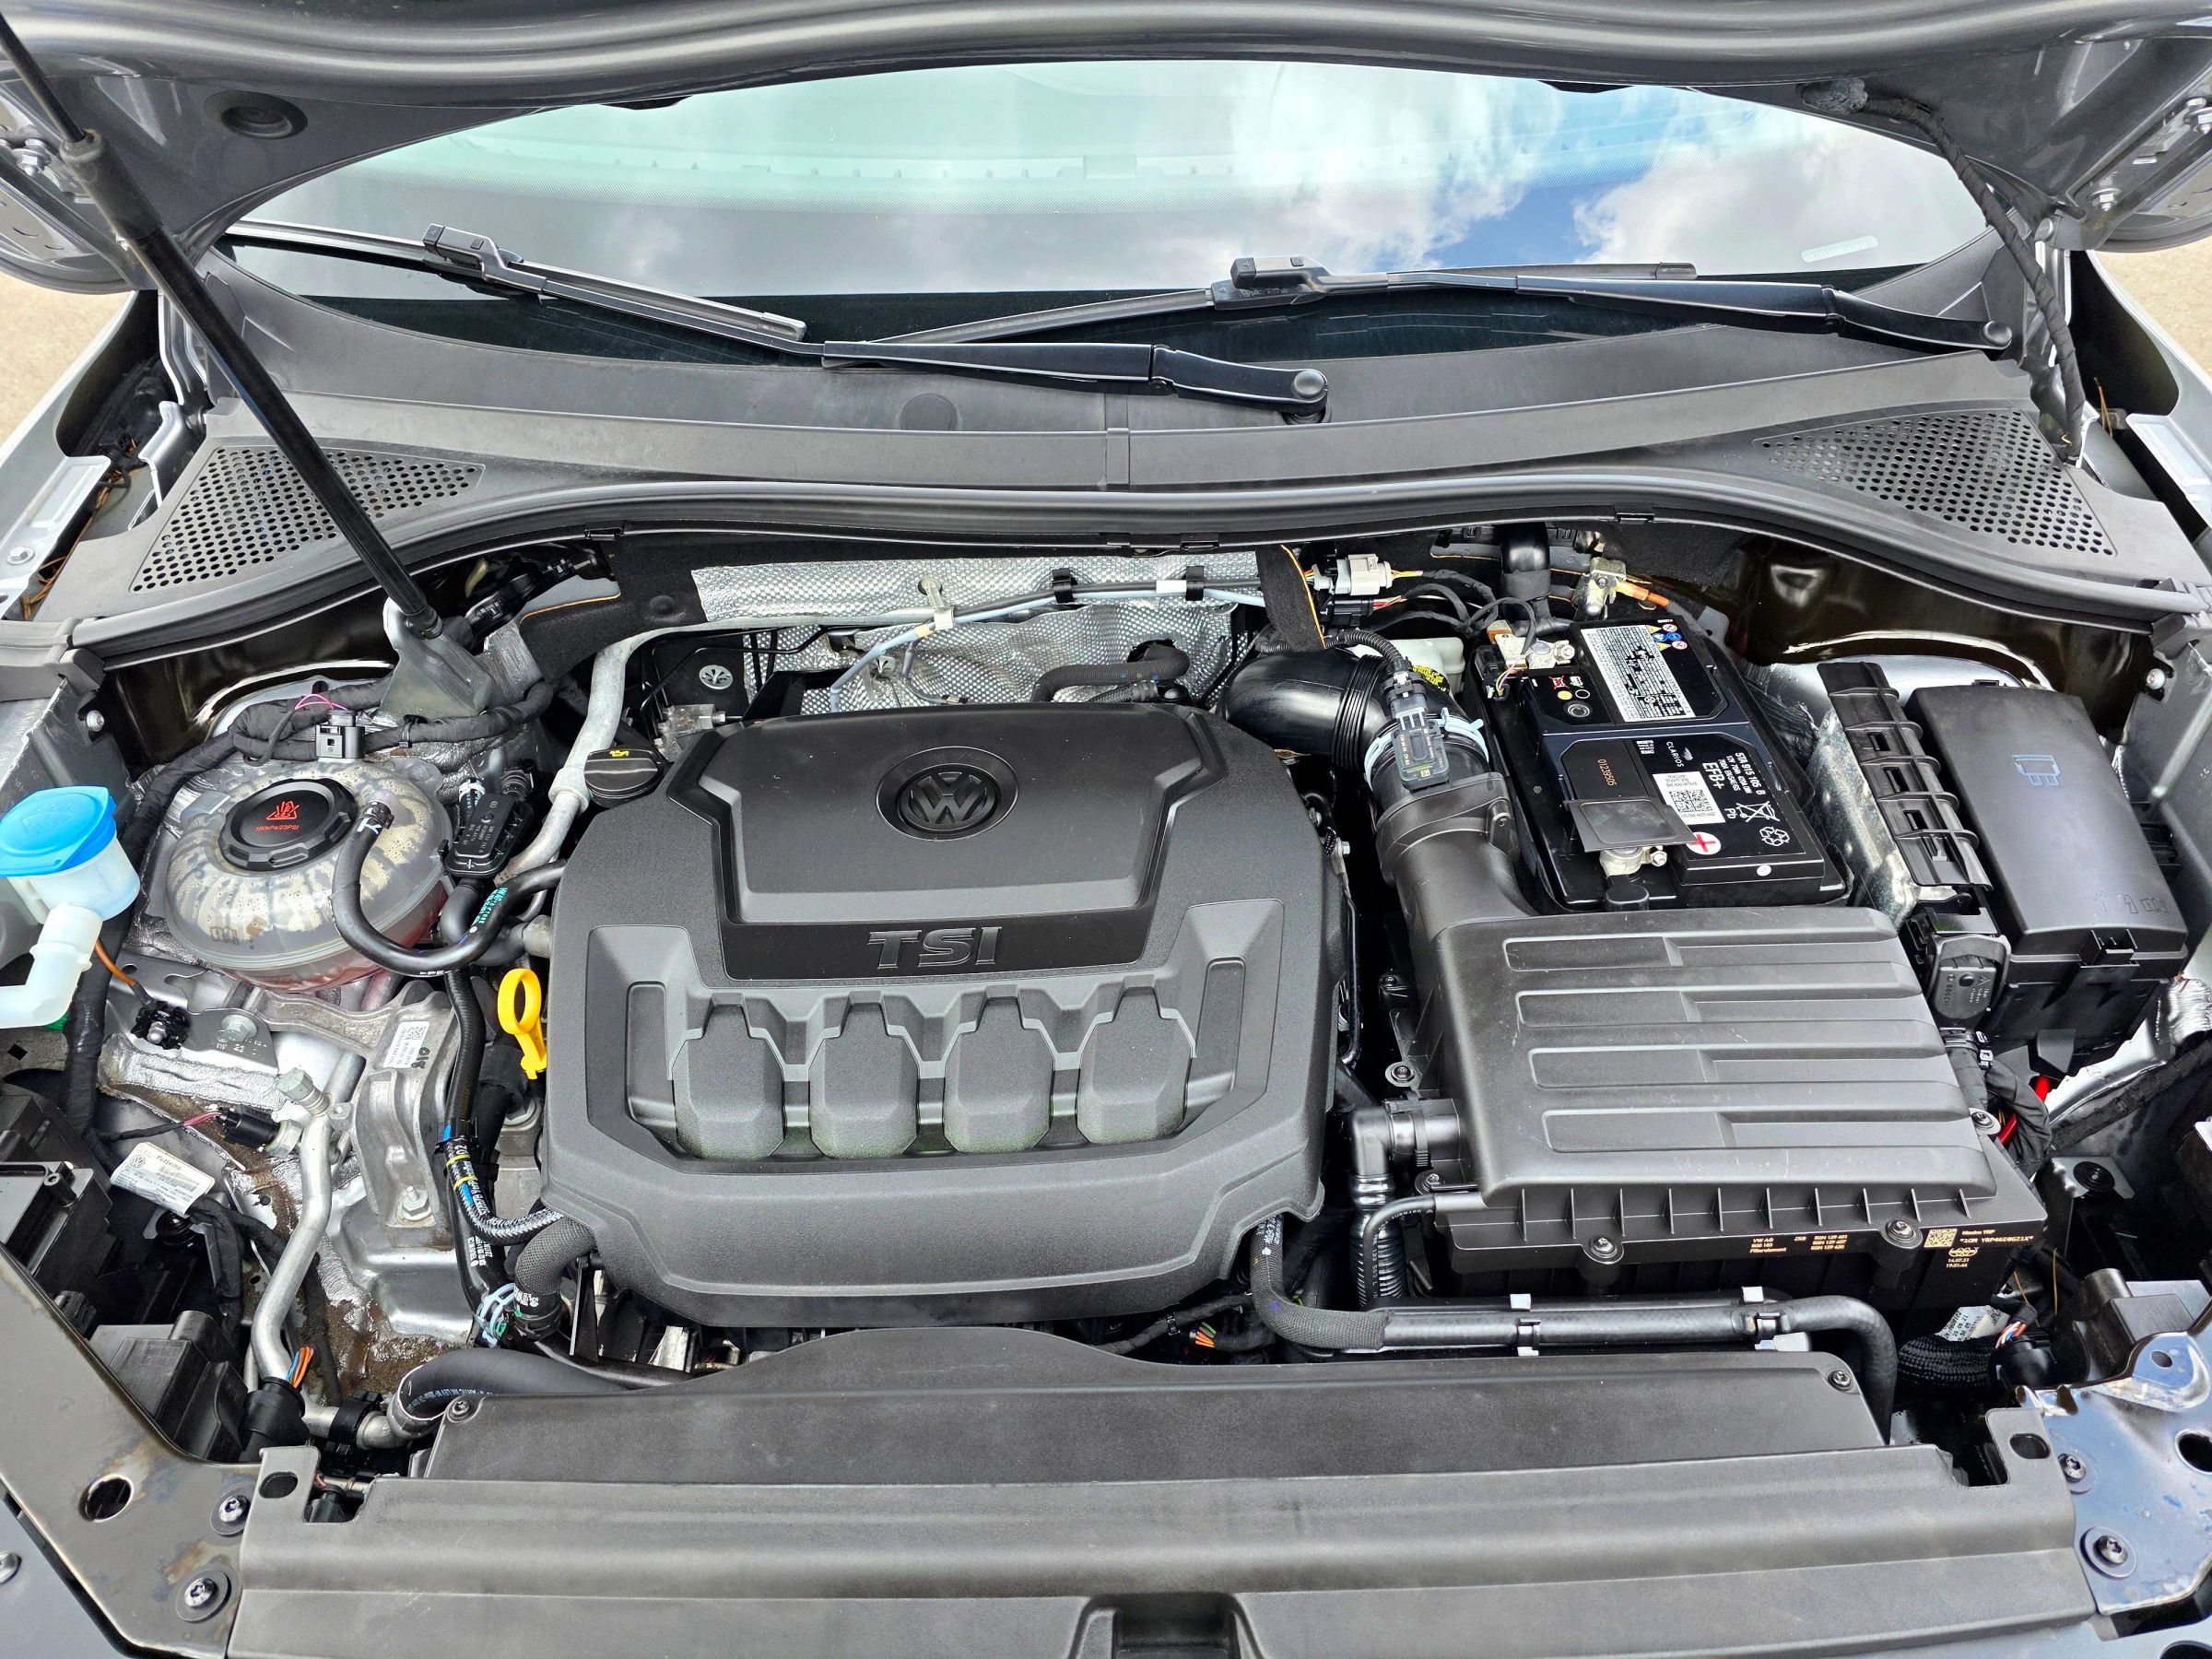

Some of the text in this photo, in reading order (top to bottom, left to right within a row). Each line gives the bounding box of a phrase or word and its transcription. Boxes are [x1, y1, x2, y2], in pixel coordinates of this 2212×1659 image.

[1666, 741, 1684, 767] CLARIOS
[1735, 752, 1747, 763] 5TA
[1742, 764, 1755, 775] 915
[1702, 762, 1724, 789] EFB+
[901, 771, 995, 830] VW
[1724, 808, 1737, 818] Pb
[867, 926, 1003, 970] TSI
